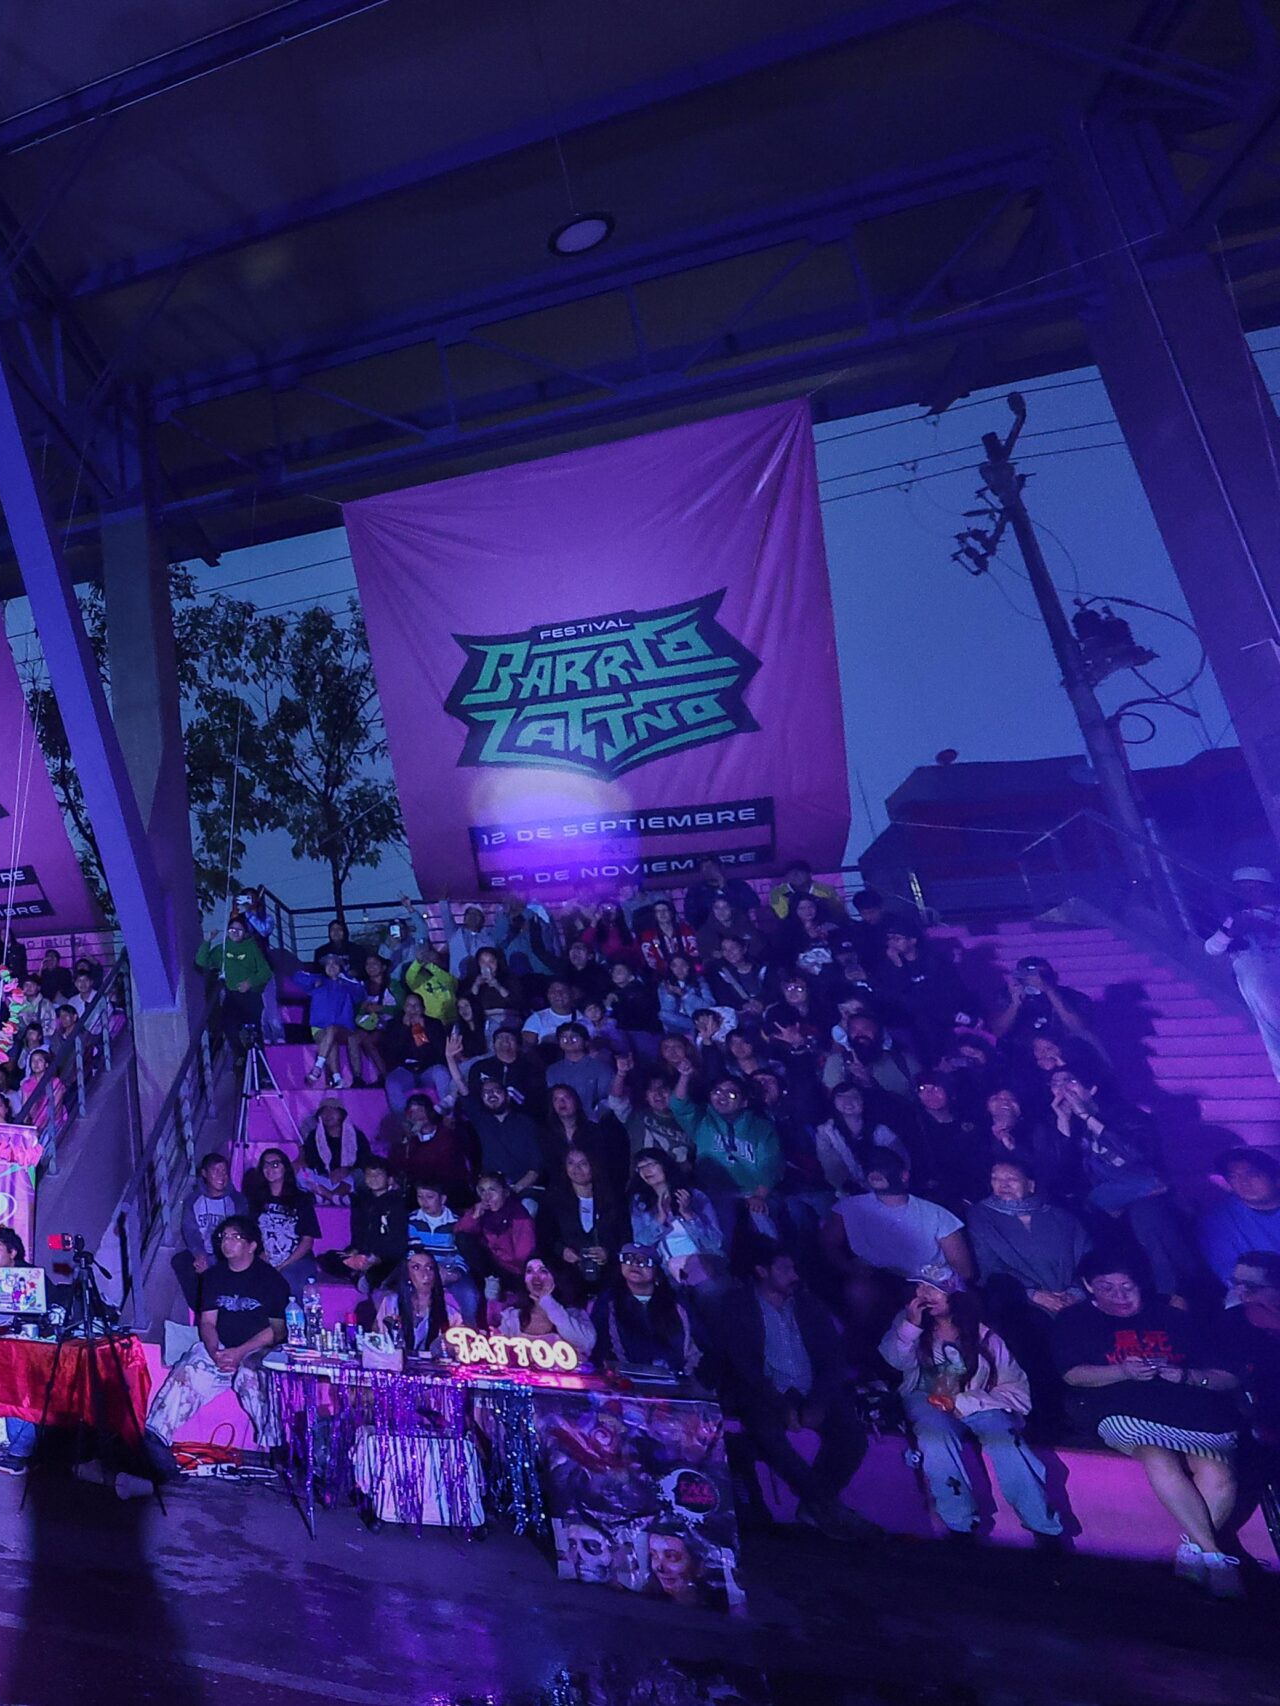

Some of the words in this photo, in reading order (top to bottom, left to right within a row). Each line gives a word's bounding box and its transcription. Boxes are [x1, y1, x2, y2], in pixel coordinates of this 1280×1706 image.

[540, 619, 630, 640] FESTIVAL
[460, 607, 741, 705] BARRIO
[467, 674, 740, 773] LATINO
[482, 831, 507, 845] 12
[517, 827, 553, 842] DE
[563, 808, 756, 837] SEPTIEMBRE
[535, 870, 569, 883] DE
[581, 852, 756, 879] NOVIEMRE
[446, 1327, 578, 1370] TATTOO
